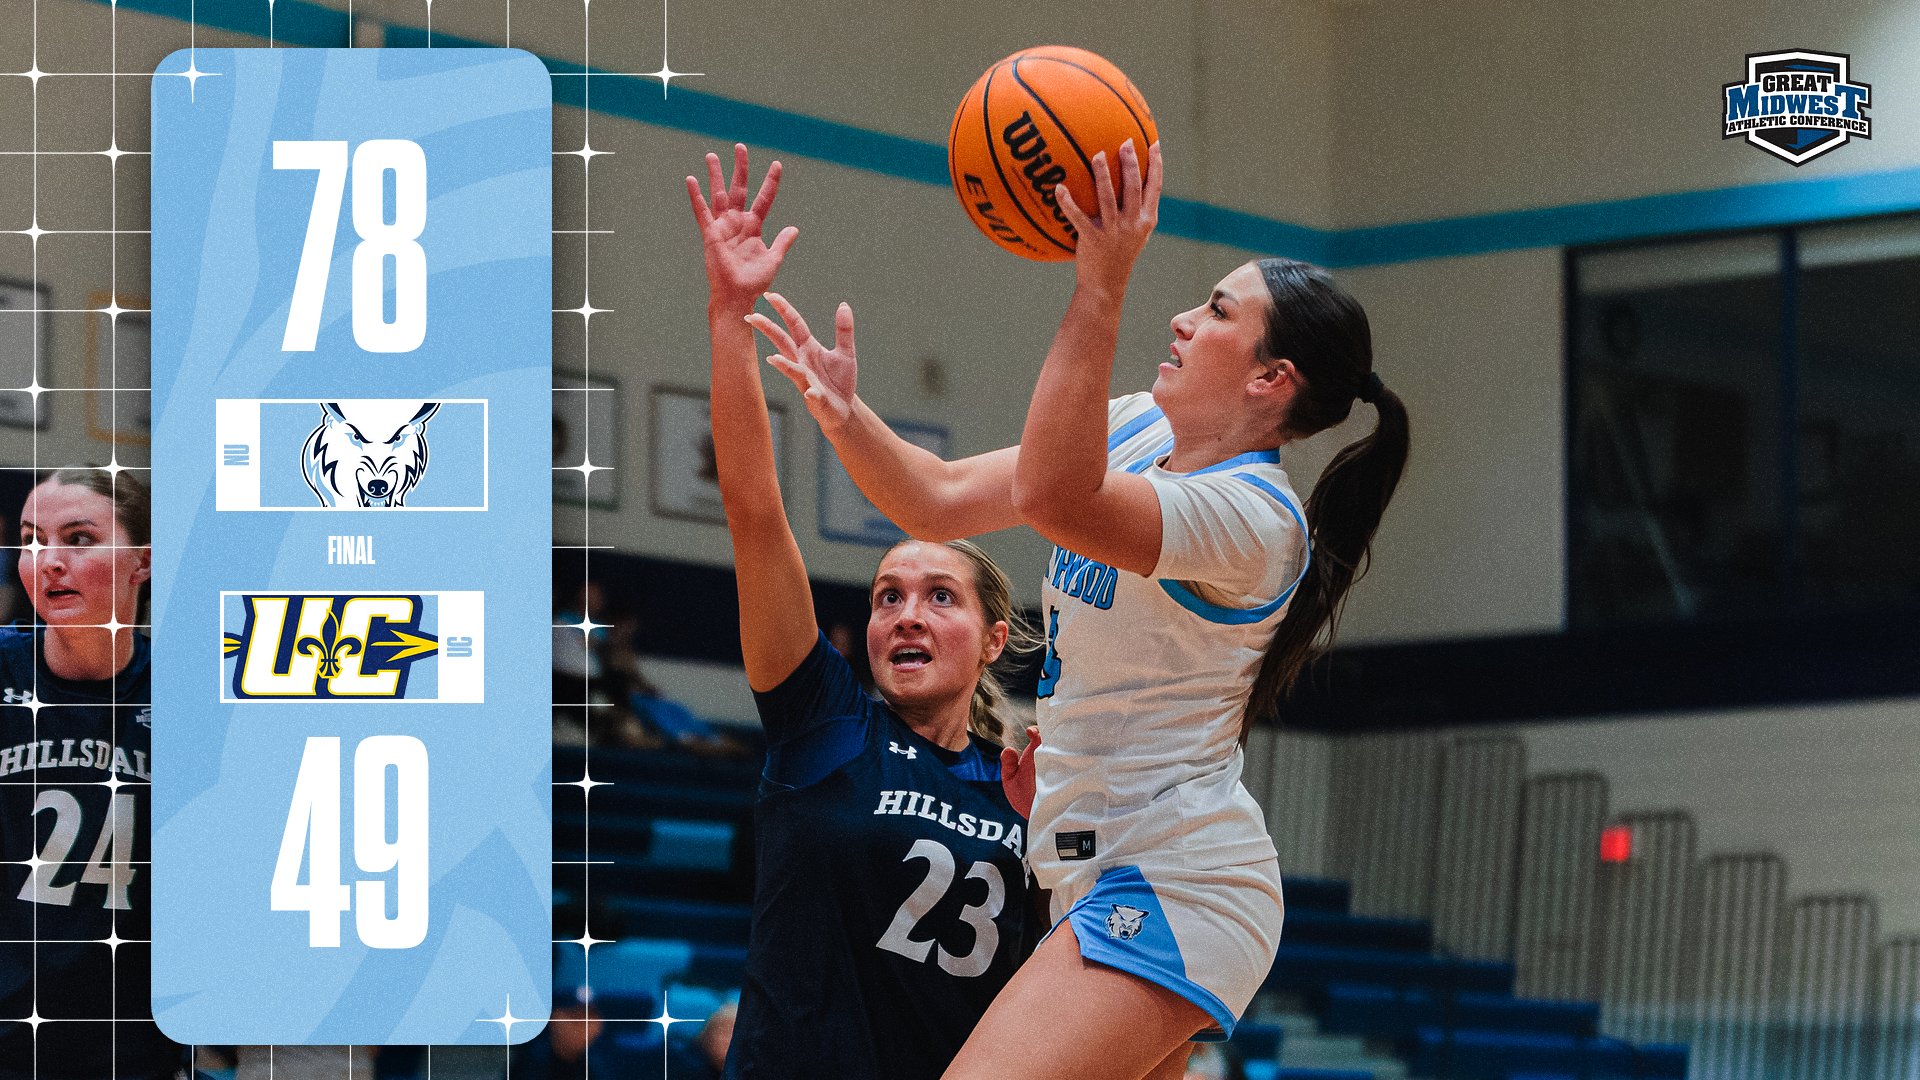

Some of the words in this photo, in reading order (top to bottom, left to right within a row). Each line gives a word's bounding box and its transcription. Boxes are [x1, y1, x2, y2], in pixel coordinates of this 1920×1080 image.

[17, 789, 136, 911] 24
[873, 790, 1026, 866] HILLSDA
[1082, 840, 1091, 851] M
[876, 838, 1006, 977] 23
